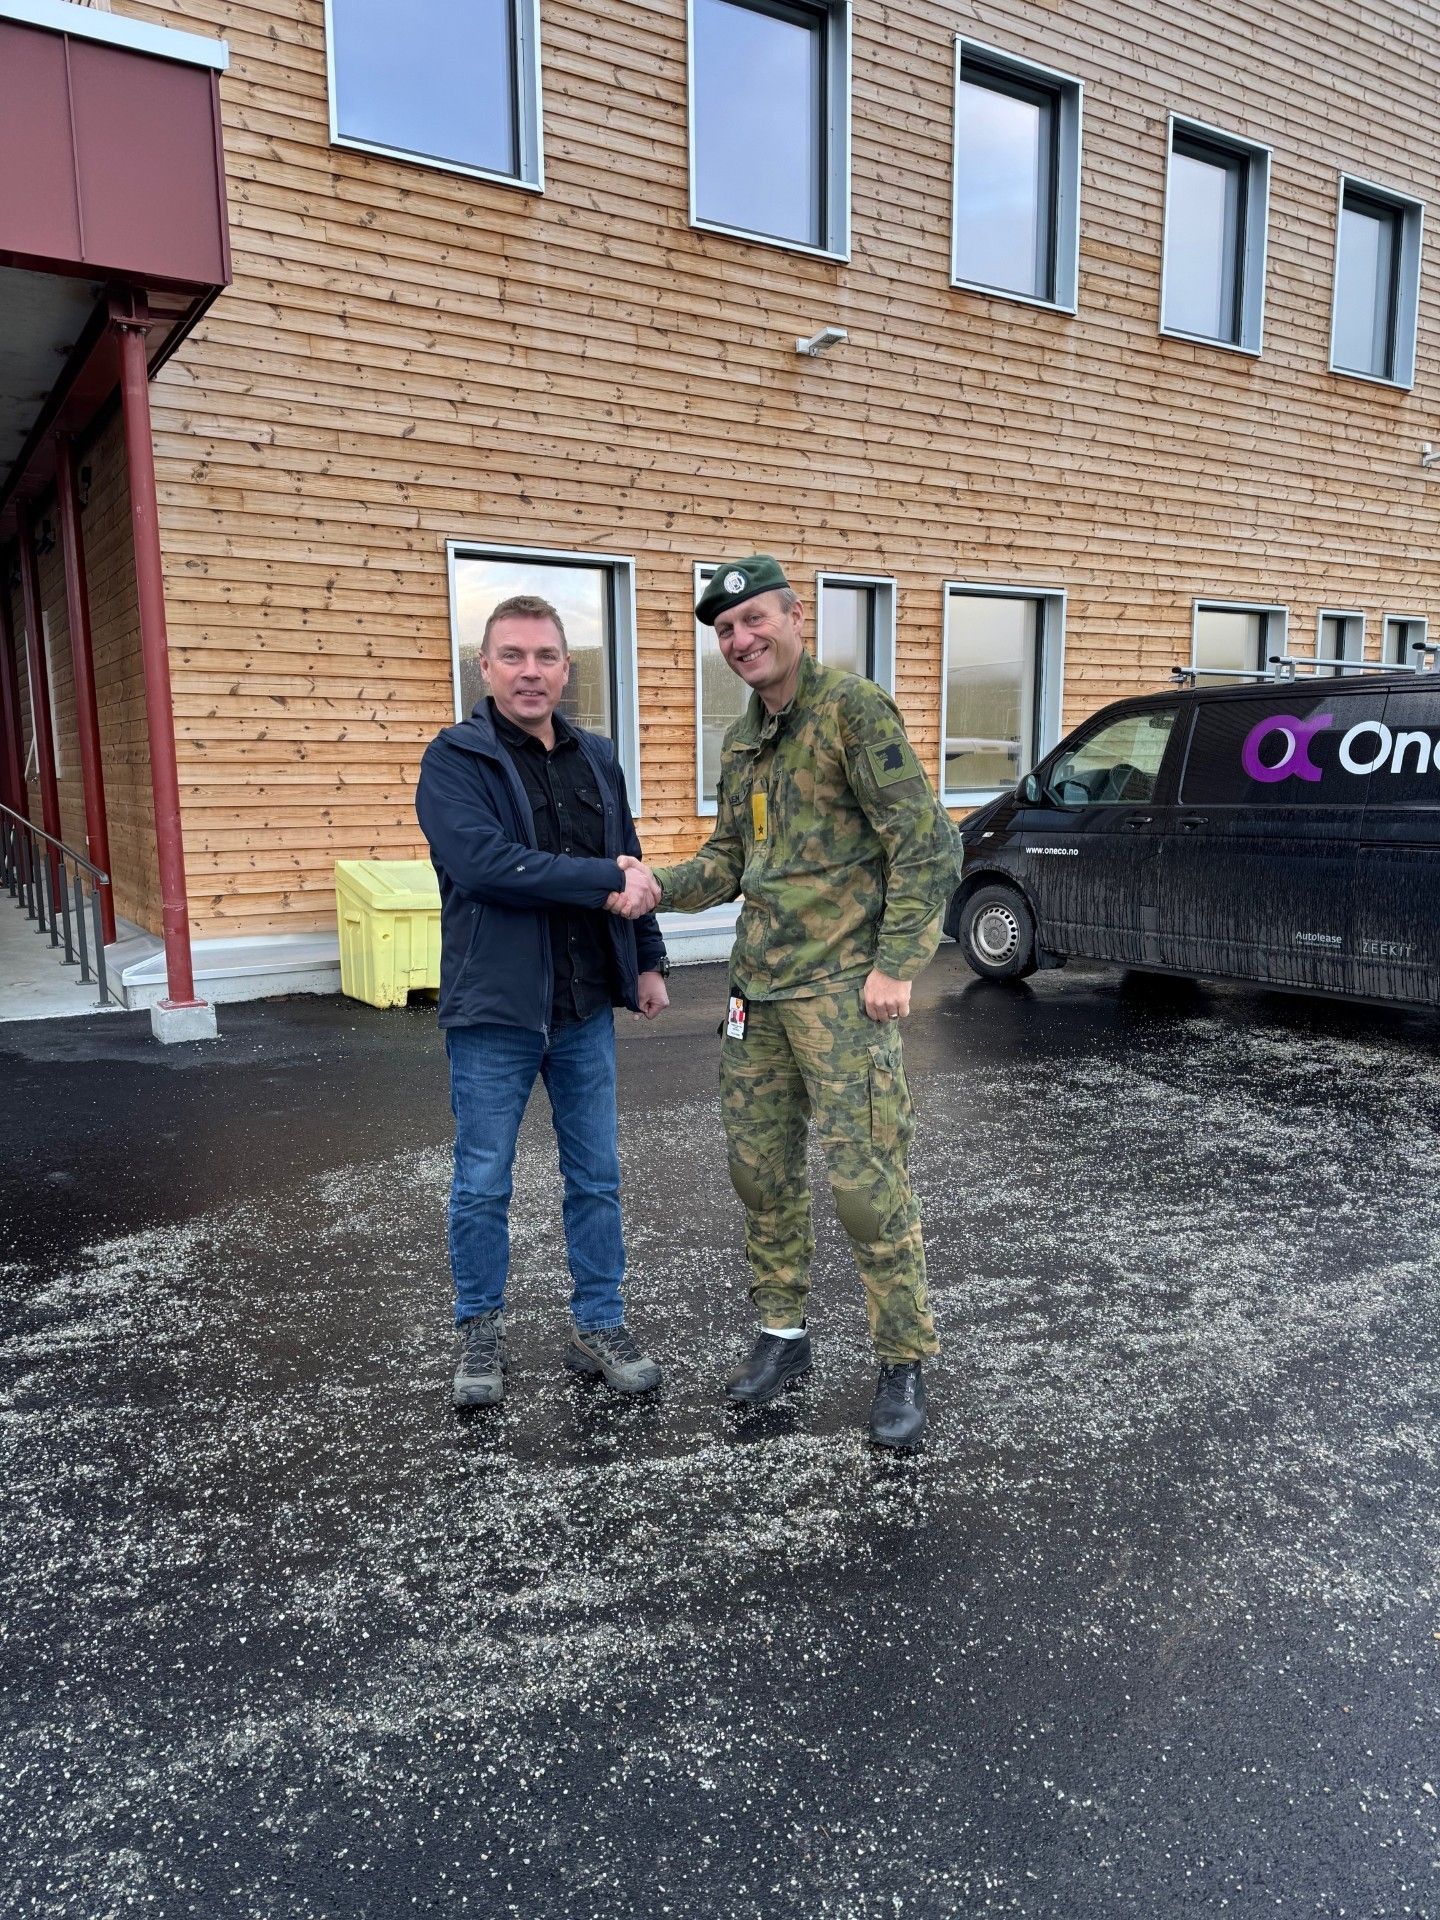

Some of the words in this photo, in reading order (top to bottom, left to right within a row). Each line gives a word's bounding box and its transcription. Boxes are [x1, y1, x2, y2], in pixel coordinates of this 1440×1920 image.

[1339, 720, 1440, 775] On
[1025, 847, 1079, 856] www.oneco.no
[1295, 931, 1342, 944] Autolease
[1362, 942, 1411, 957] ZEEKIT
